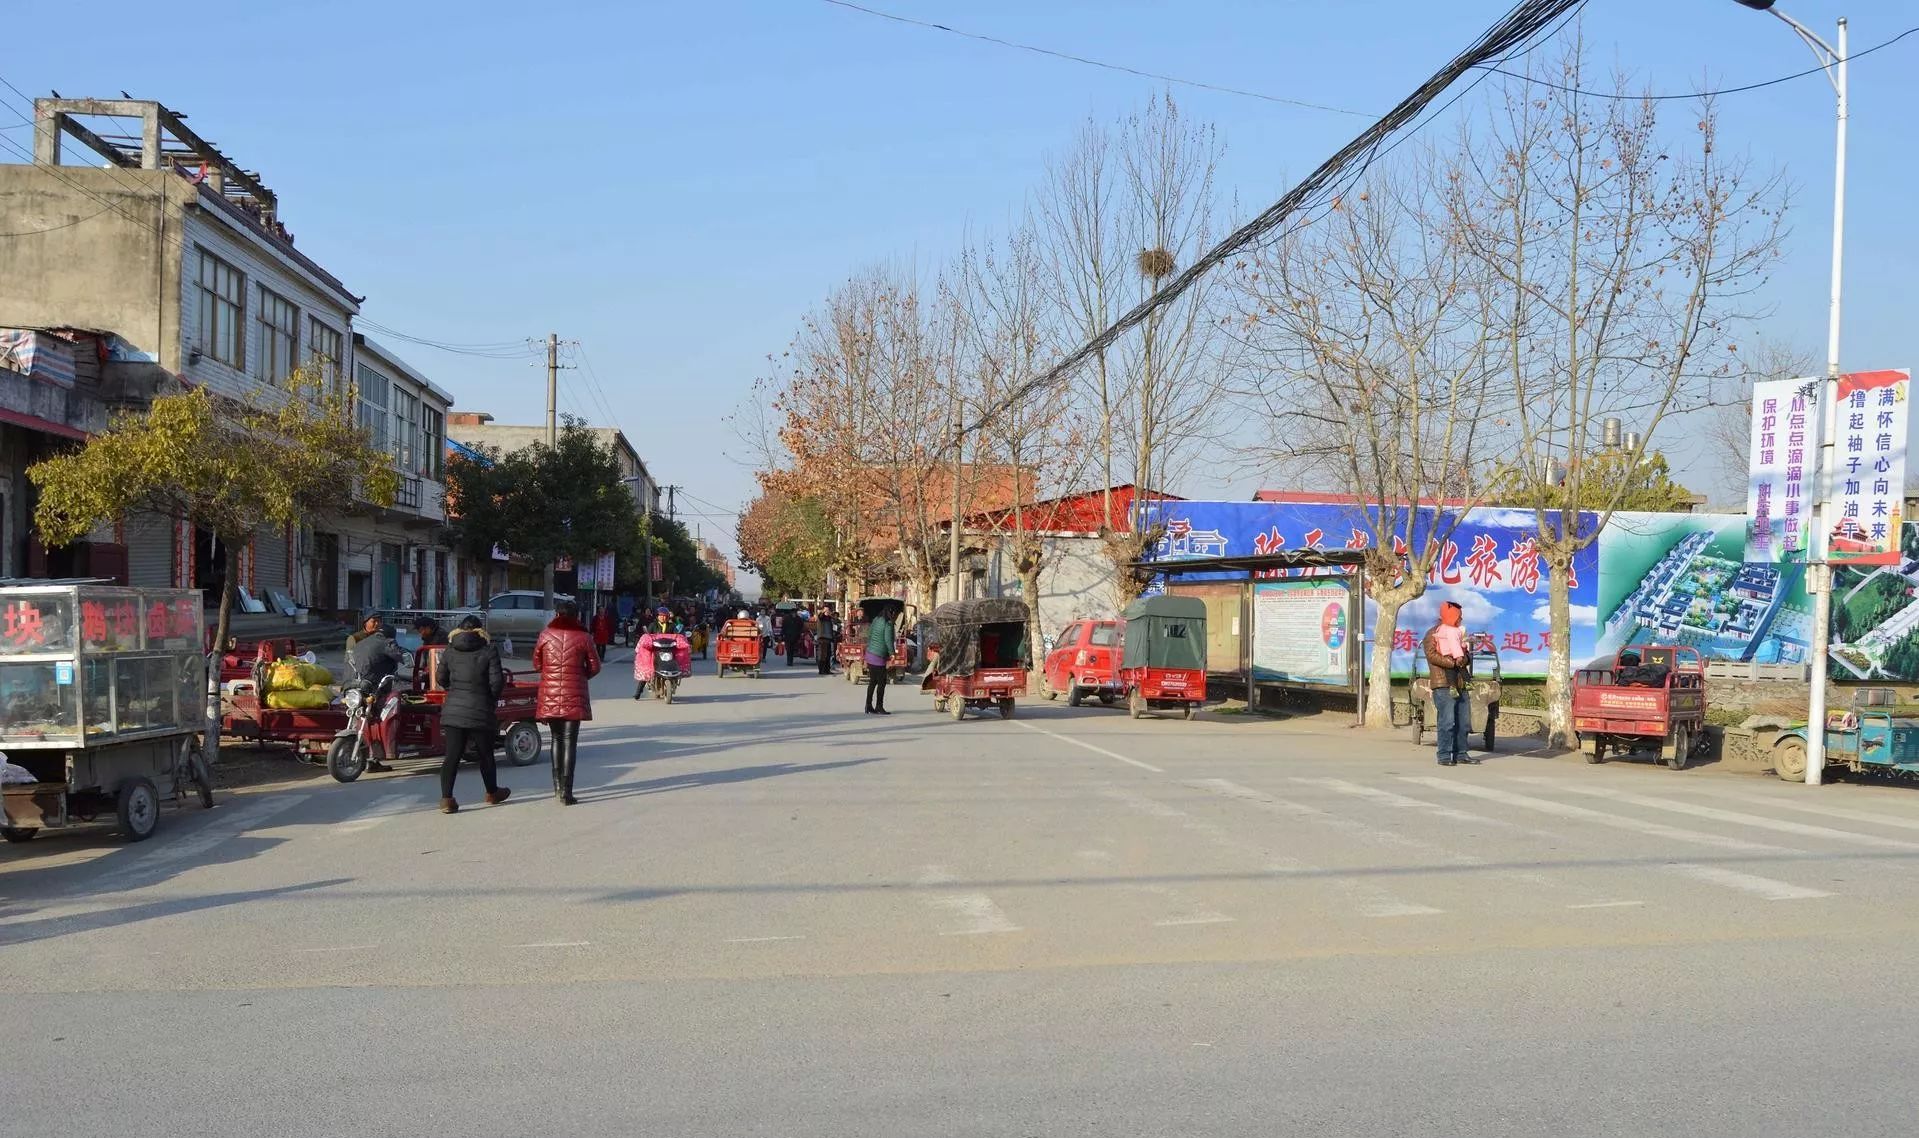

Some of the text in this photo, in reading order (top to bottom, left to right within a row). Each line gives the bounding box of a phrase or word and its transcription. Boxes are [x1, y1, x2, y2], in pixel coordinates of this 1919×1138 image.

[1759, 398, 1777, 464] 保护环境
[1842, 390, 1866, 540] 撸起袖子加油干
[1871, 388, 1895, 540] 满怀信心向未来
[3, 600, 46, 645] 块
